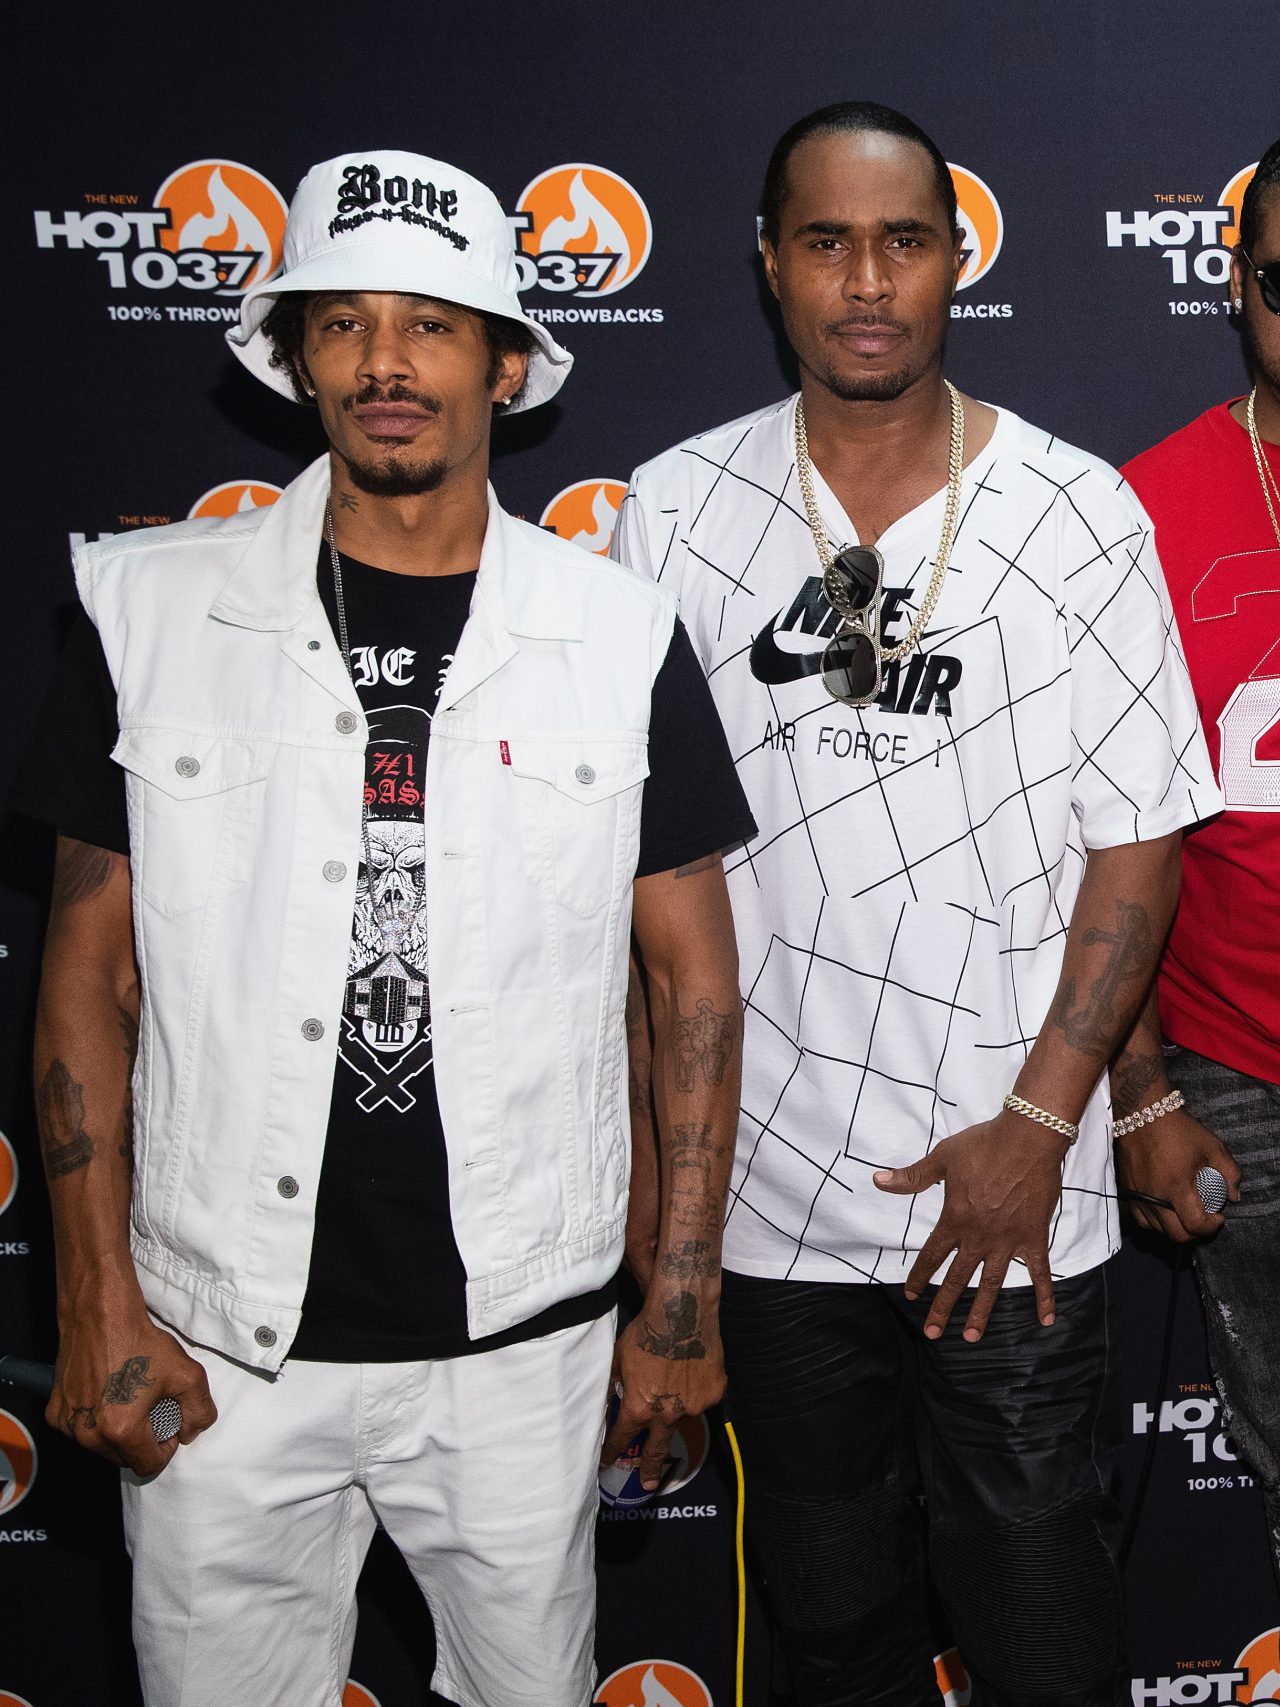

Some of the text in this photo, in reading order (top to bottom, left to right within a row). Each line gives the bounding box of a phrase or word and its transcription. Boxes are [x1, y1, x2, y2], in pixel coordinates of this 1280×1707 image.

[84, 193, 138, 205] THE NEW
[337, 164, 457, 222] Bone
[1154, 194, 1204, 203] THE NEW
[34, 210, 167, 248] HOT
[1106, 210, 1229, 247] HOT
[515, 255, 613, 292] 03.7
[107, 306, 241, 321] 100% THROW
[950, 304, 1013, 318] BACKS
[1168, 301, 1218, 315] 100%
[525, 309, 664, 323] THROWBACKS
[118, 515, 171, 525] THE NEW
[762, 720, 796, 752] AIR
[817, 726, 909, 765] FORCE
[1178, 1384, 1198, 1392] THE
[1133, 1398, 1219, 1434] HO
[1187, 1476, 1234, 1491] 100%
[1176, 1659, 1222, 1669] THE NEW
[1131, 1672, 1244, 1707] HOT
